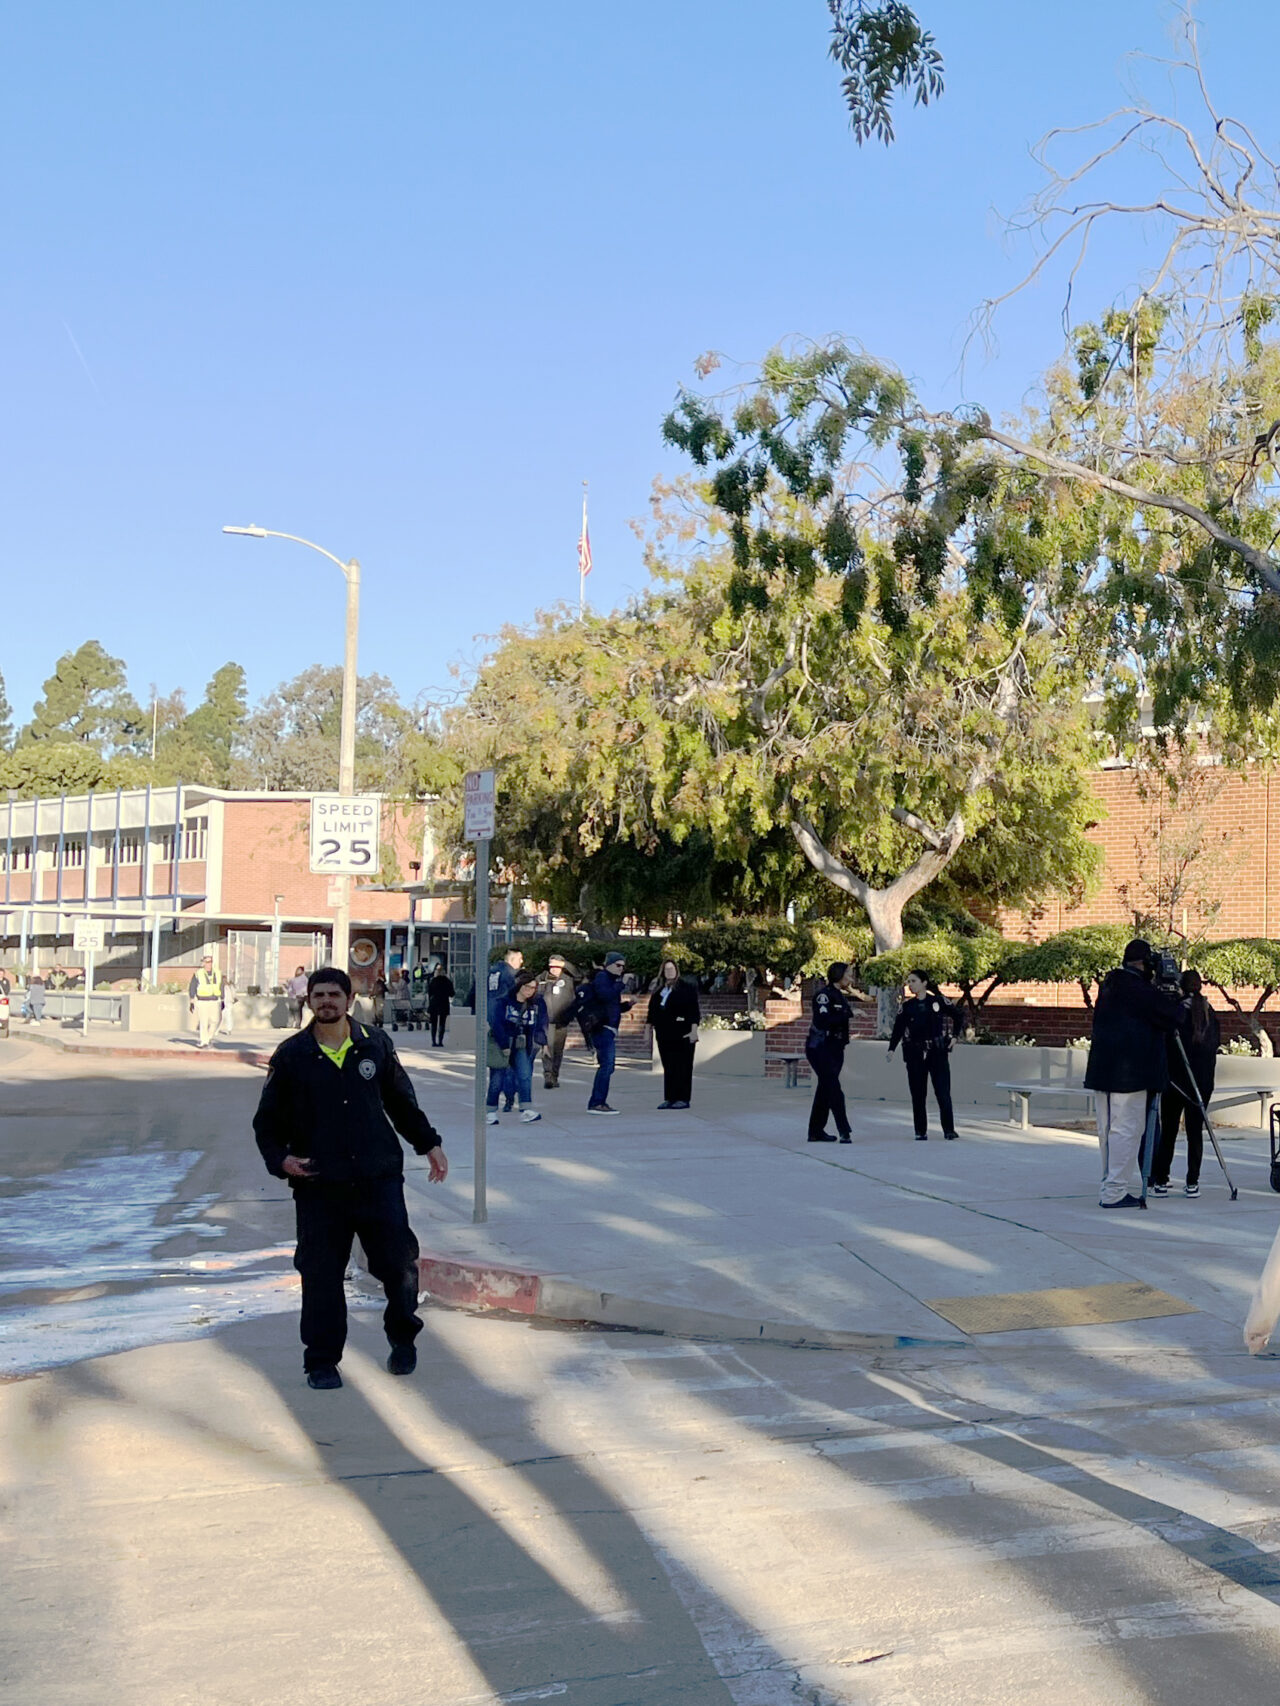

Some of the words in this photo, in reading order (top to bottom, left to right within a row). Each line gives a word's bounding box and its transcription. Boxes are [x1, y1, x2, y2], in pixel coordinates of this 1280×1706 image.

[466, 774, 479, 790] NO
[318, 803, 374, 816] SPEED
[323, 821, 367, 833] LIMIT
[318, 838, 371, 866] 25
[78, 936, 99, 947] 25
